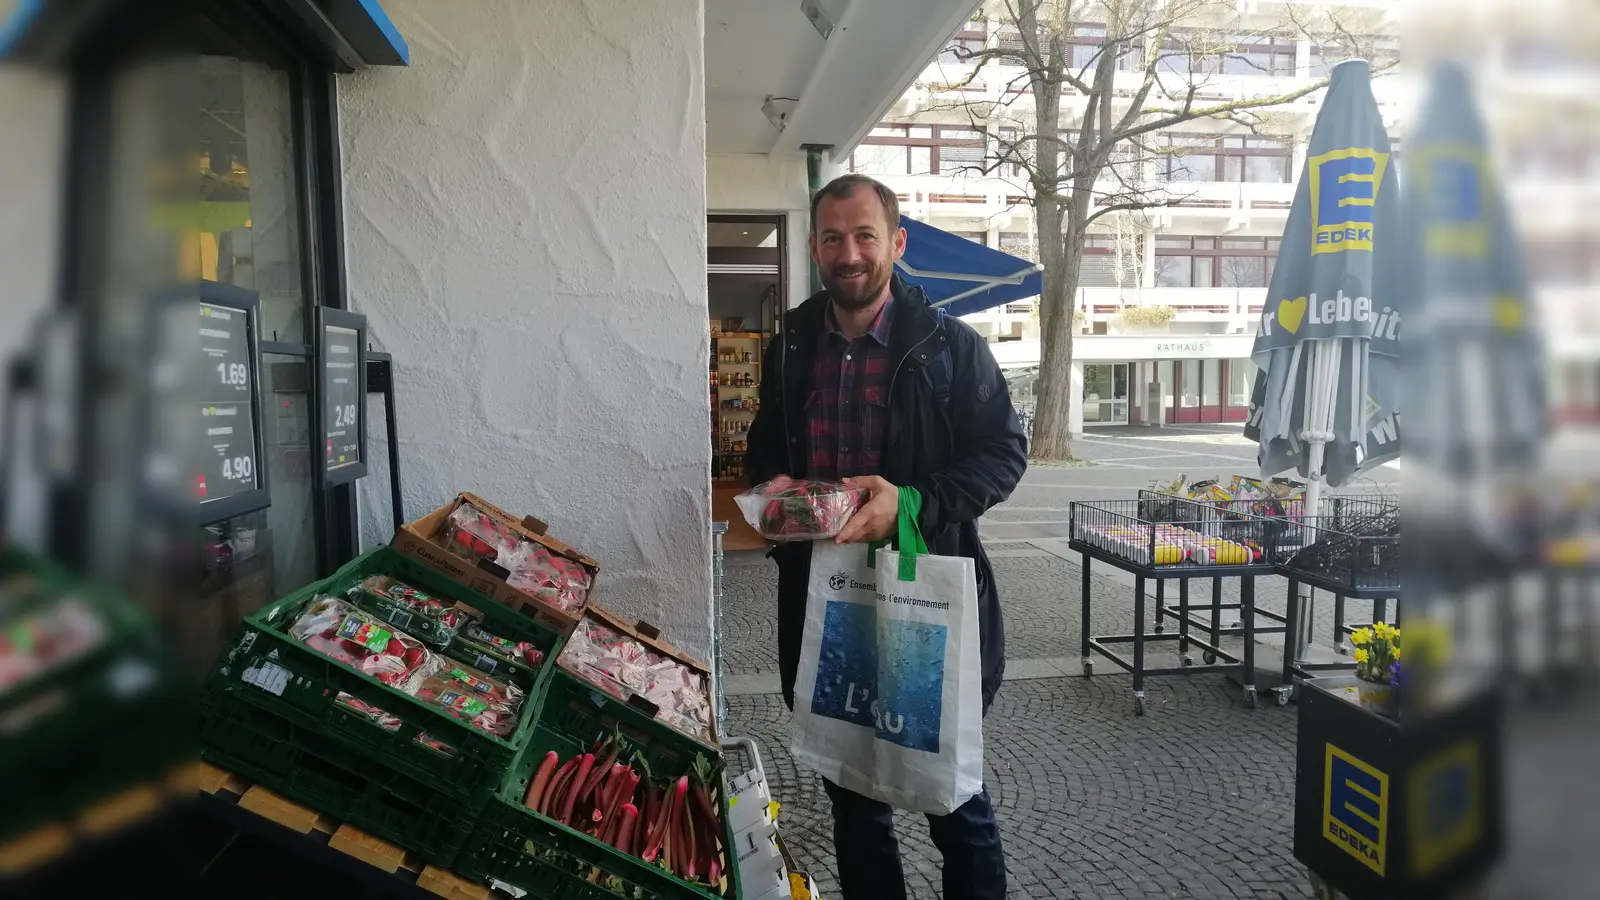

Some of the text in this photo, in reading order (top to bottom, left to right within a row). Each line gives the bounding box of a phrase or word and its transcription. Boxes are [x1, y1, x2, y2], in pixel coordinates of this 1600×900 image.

[1317, 157, 1375, 226] E
[1316, 228, 1373, 244] EDEK
[1308, 290, 1372, 324] Lebe
[1157, 343, 1204, 351] RATHAUS
[217, 362, 247, 385] 1.69
[335, 404, 356, 427] 2.49
[223, 455, 252, 480] 4.90
[889, 593, 950, 610] l'environnement
[1329, 821, 1380, 865] EDEKA
